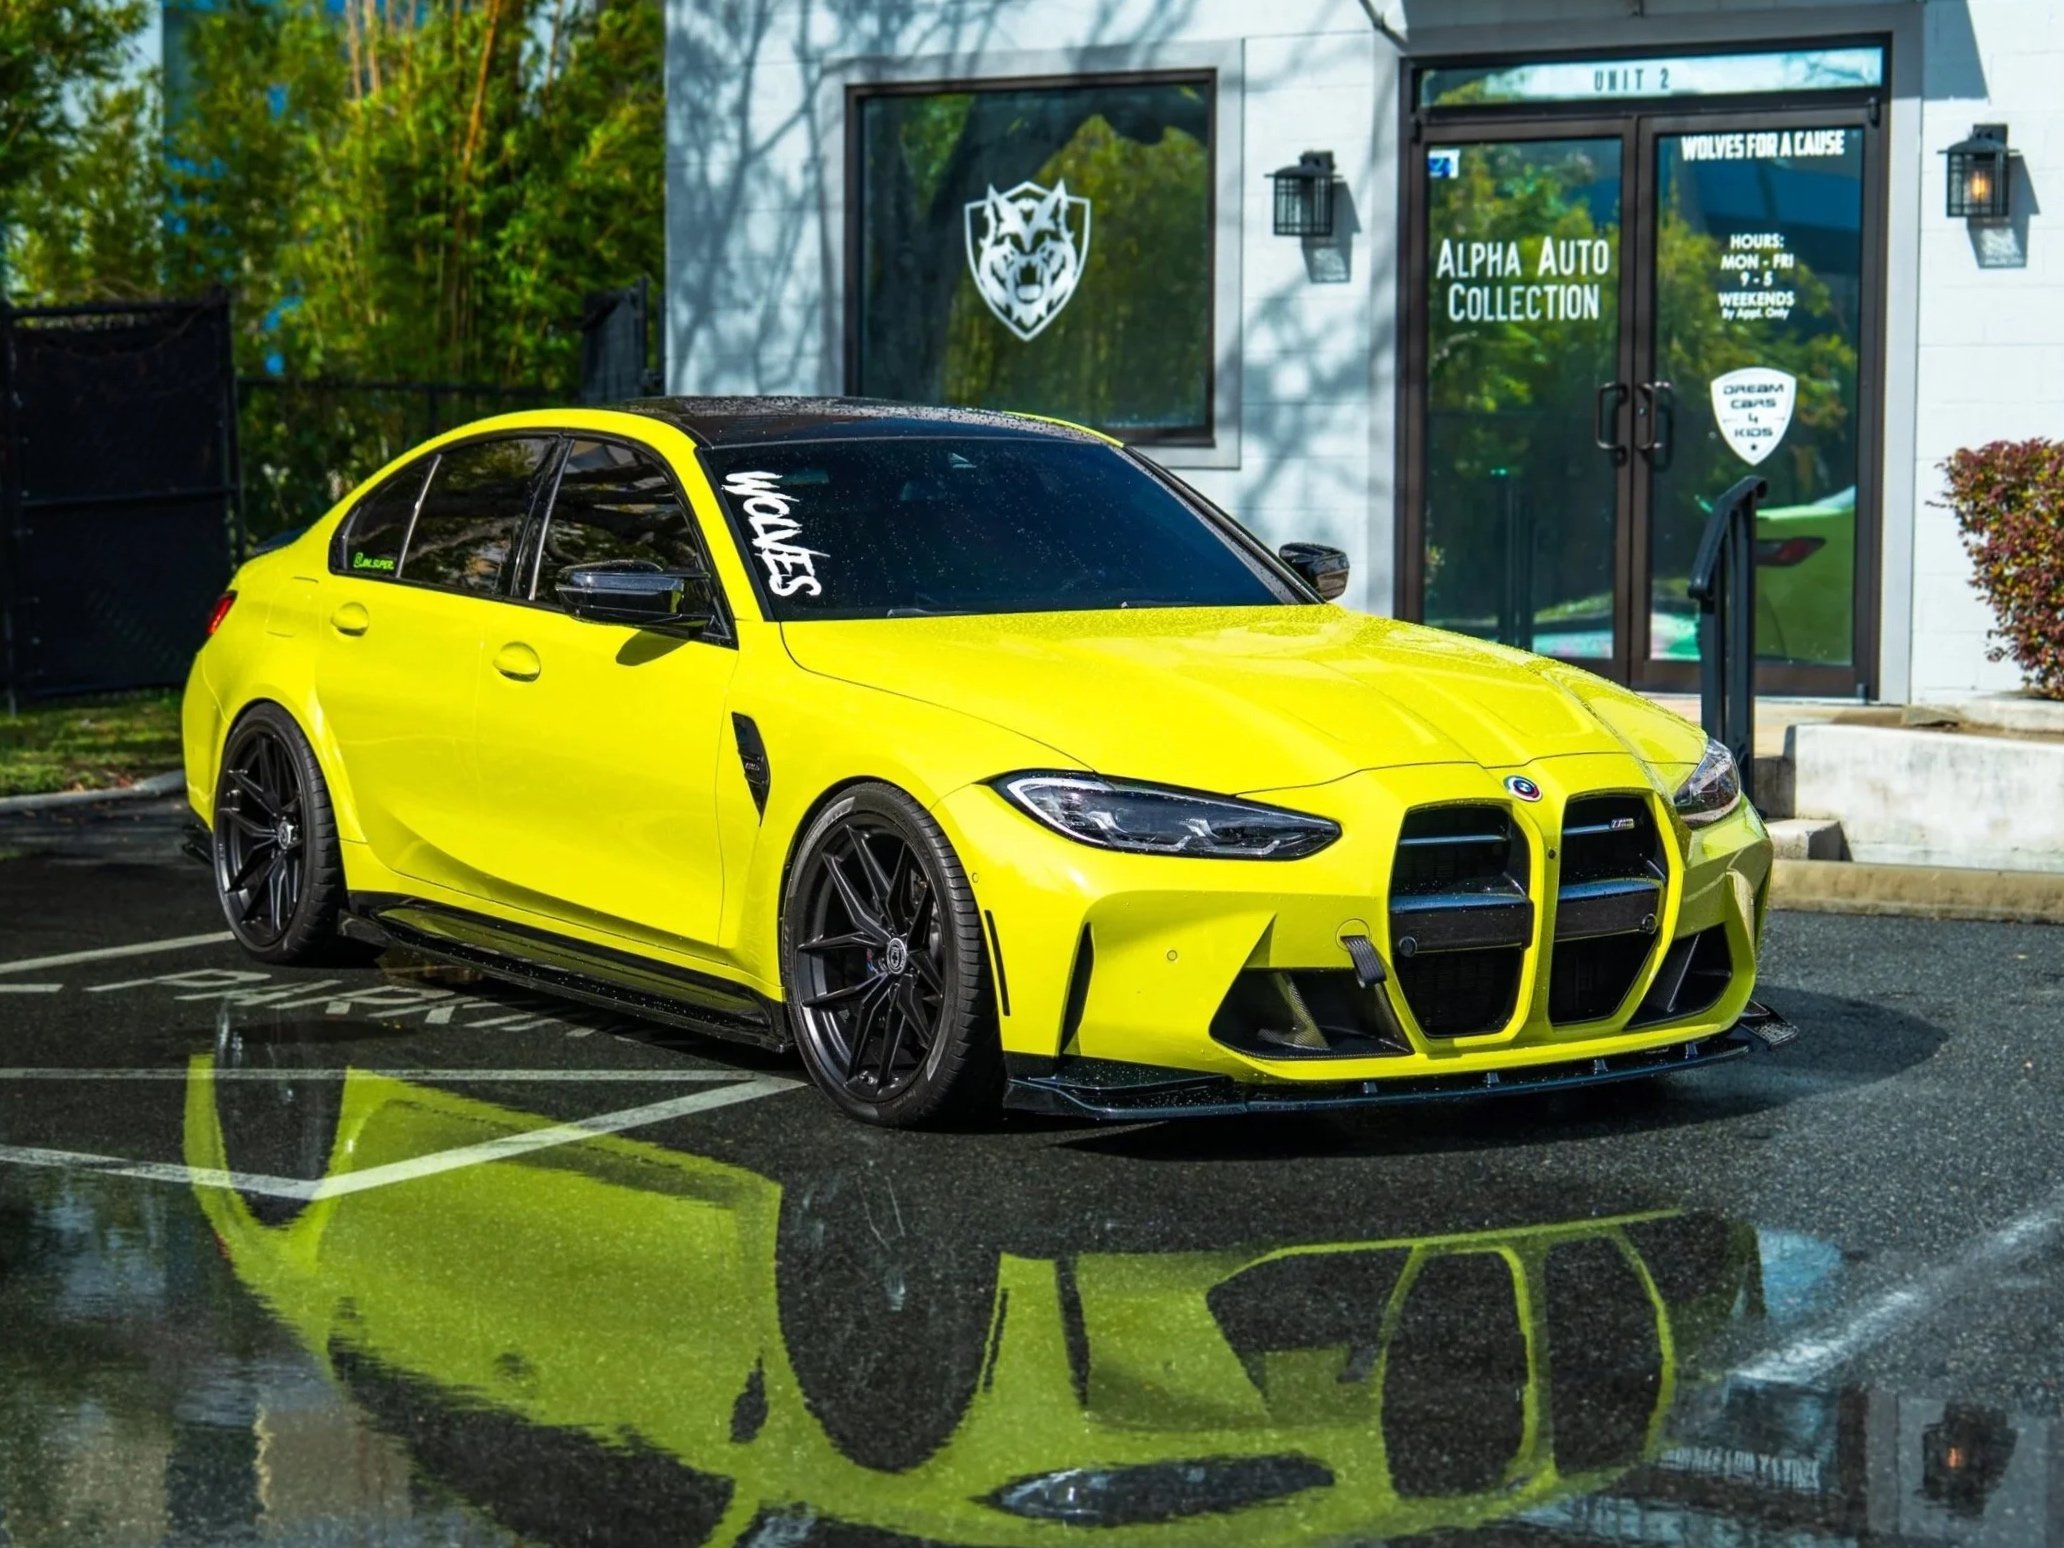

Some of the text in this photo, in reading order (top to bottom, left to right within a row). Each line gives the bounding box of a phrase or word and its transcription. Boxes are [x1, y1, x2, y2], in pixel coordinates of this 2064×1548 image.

[1594, 67, 1669, 91] UNIT 2
[1681, 129, 1845, 161] WOLVES FOR A CAUSE
[1730, 233, 1784, 249] HOURS:
[1436, 236, 1609, 279] ALPHA AUTO
[1721, 253, 1759, 270] MON
[1772, 253, 1794, 269] FRI
[1740, 271, 1750, 287] 9
[1763, 270, 1773, 287] 5
[1448, 282, 1599, 322] COLLECTION
[1718, 290, 1795, 307] WEEKENDS
[1748, 413, 1758, 424] 4
[1734, 427, 1773, 438] KIDS
[721, 471, 831, 596] WOLVES
